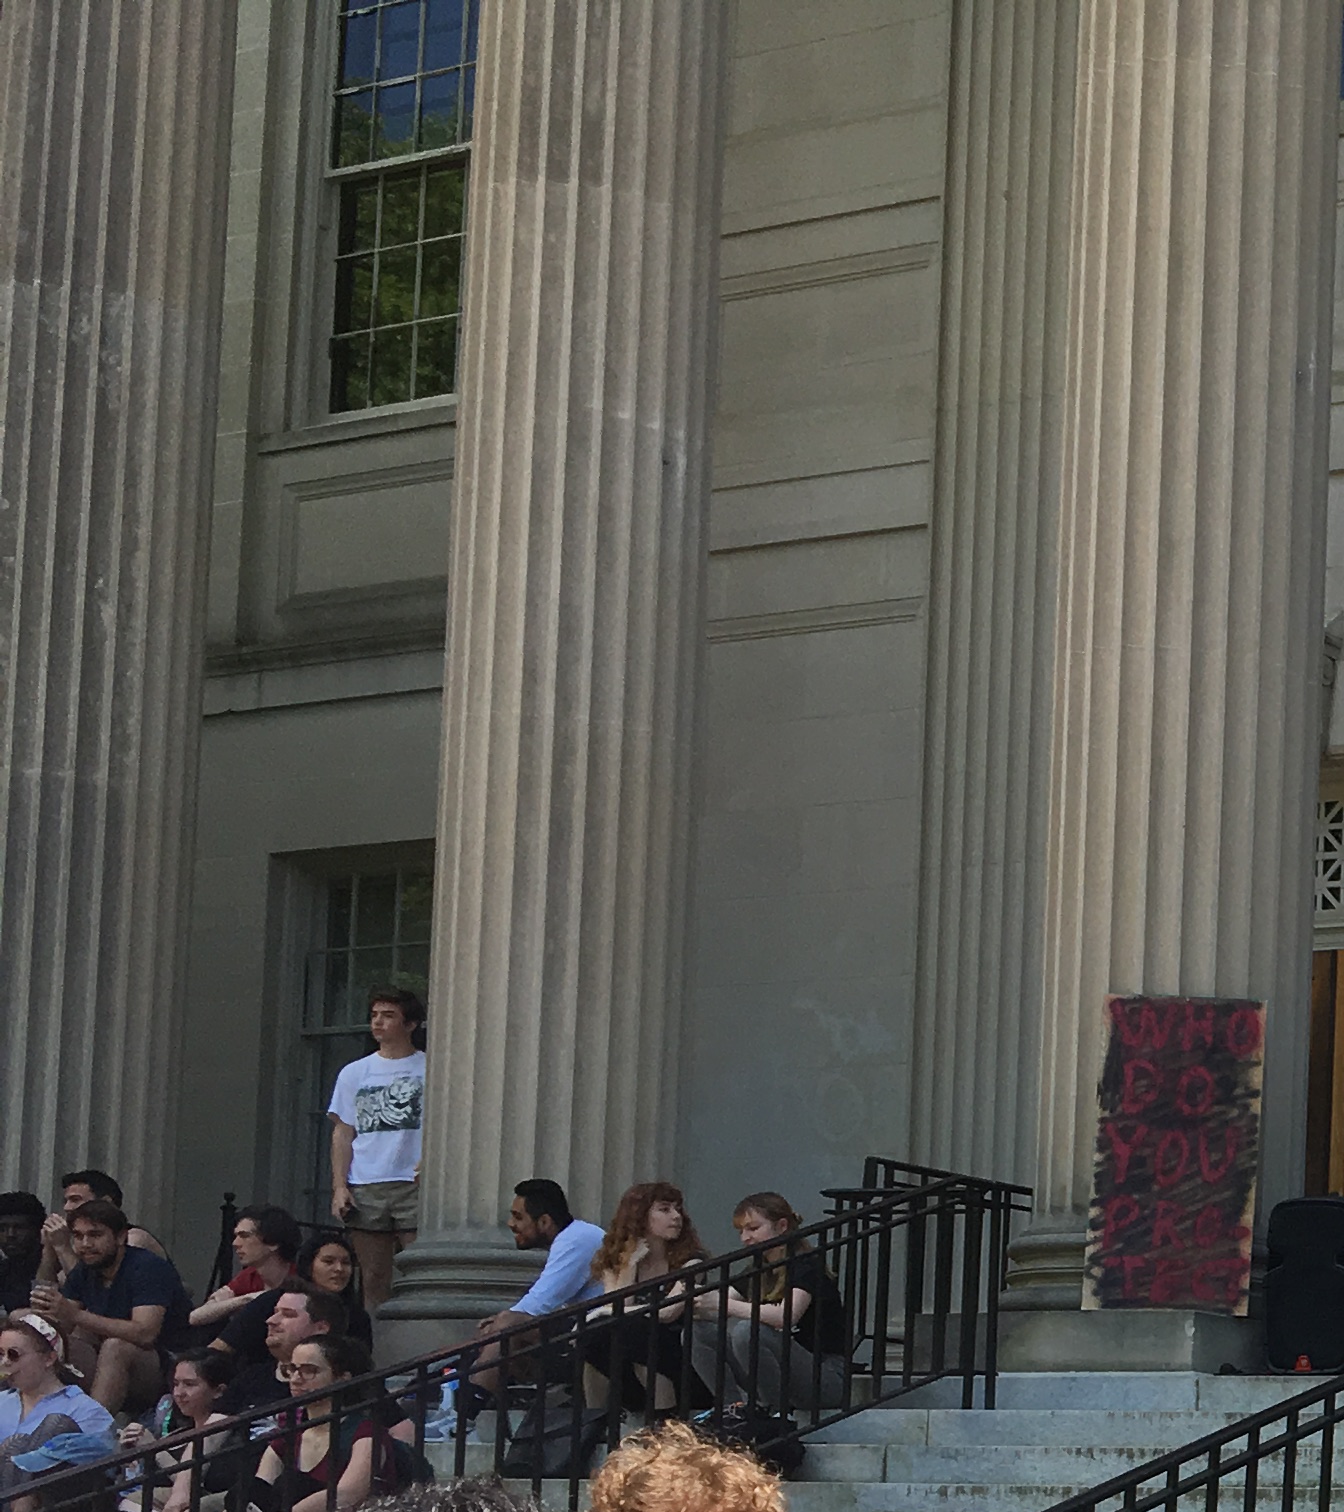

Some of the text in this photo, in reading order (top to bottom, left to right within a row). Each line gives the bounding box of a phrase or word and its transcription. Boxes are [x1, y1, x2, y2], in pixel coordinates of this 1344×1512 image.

[1109, 1002, 1261, 1059] WHO
[1120, 1058, 1215, 1116] DO
[1106, 1122, 1240, 1188] YOU
